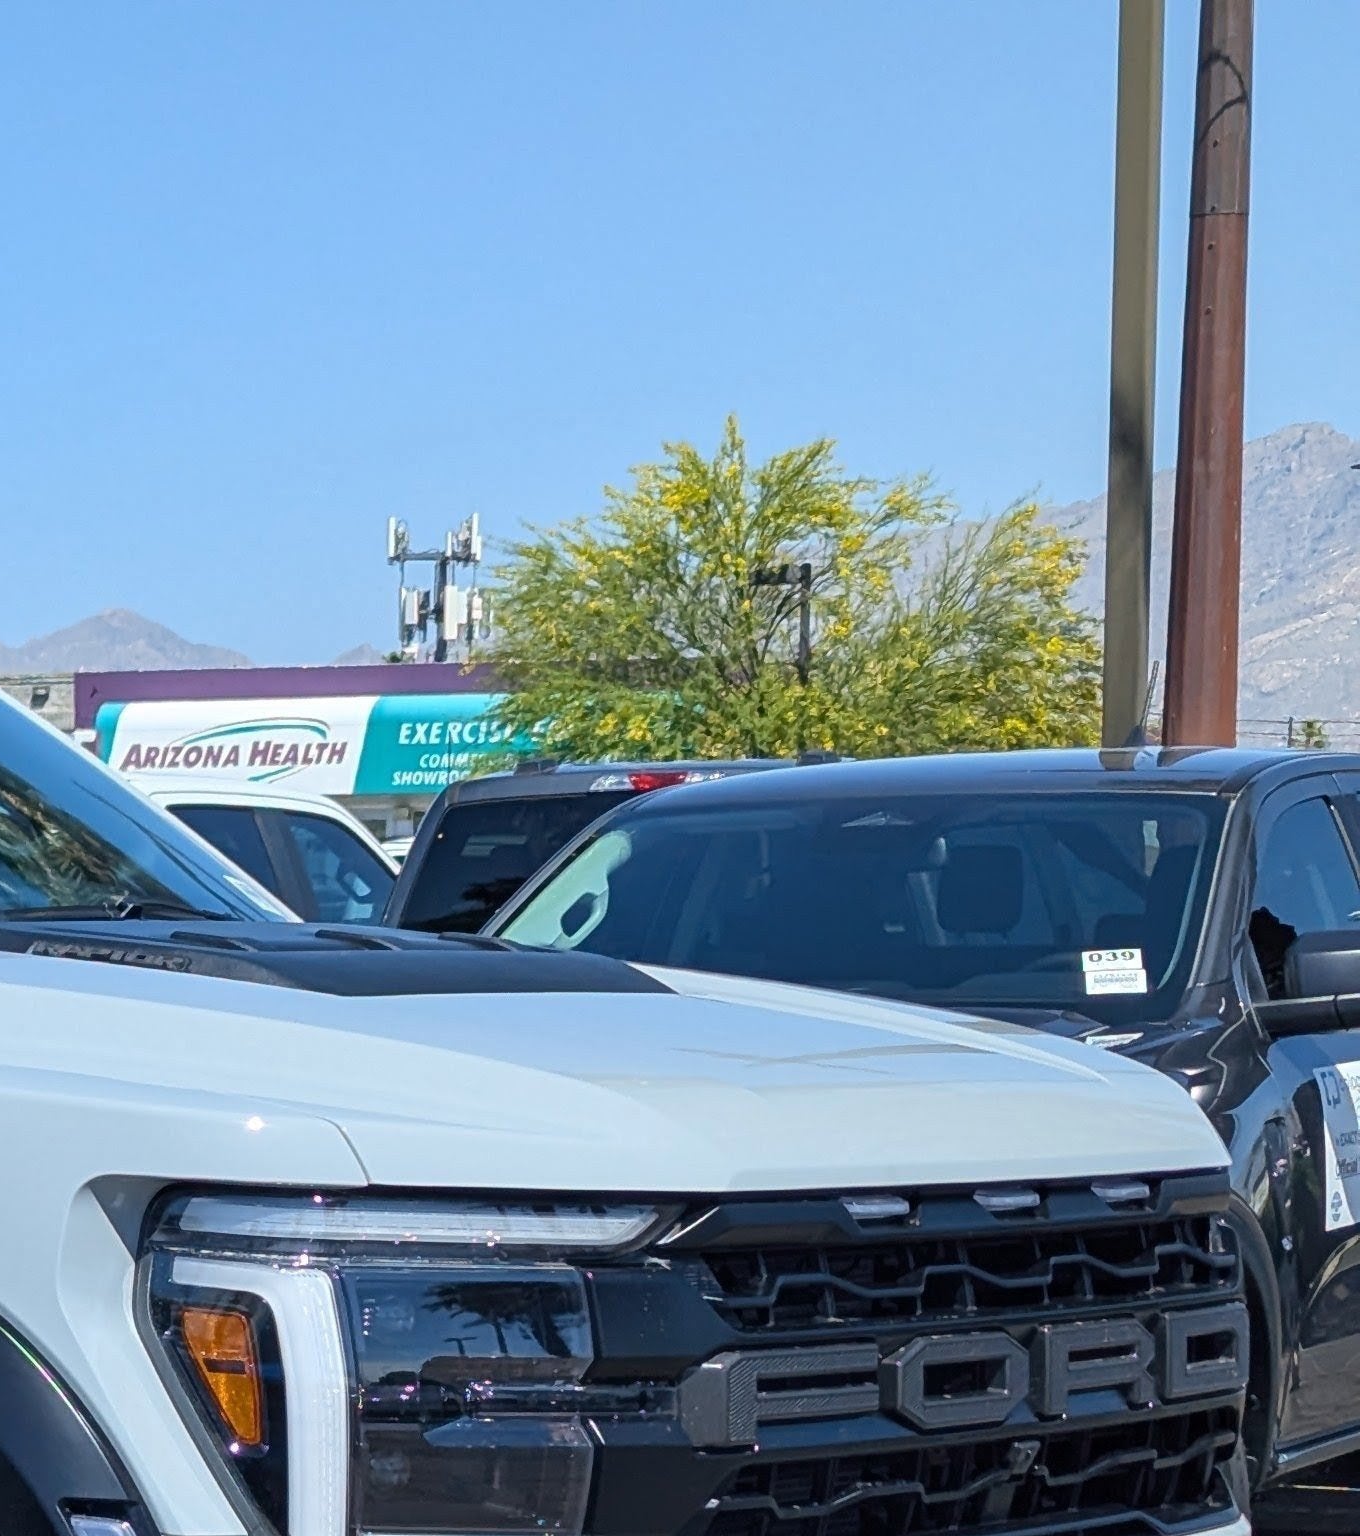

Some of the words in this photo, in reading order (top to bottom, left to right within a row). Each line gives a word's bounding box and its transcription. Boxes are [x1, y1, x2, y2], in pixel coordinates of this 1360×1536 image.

[118, 743, 240, 772] ARIZONA
[247, 740, 348, 767] HEALTH
[1088, 950, 1135, 963] 039
[680, 1302, 1250, 1446] FORD
